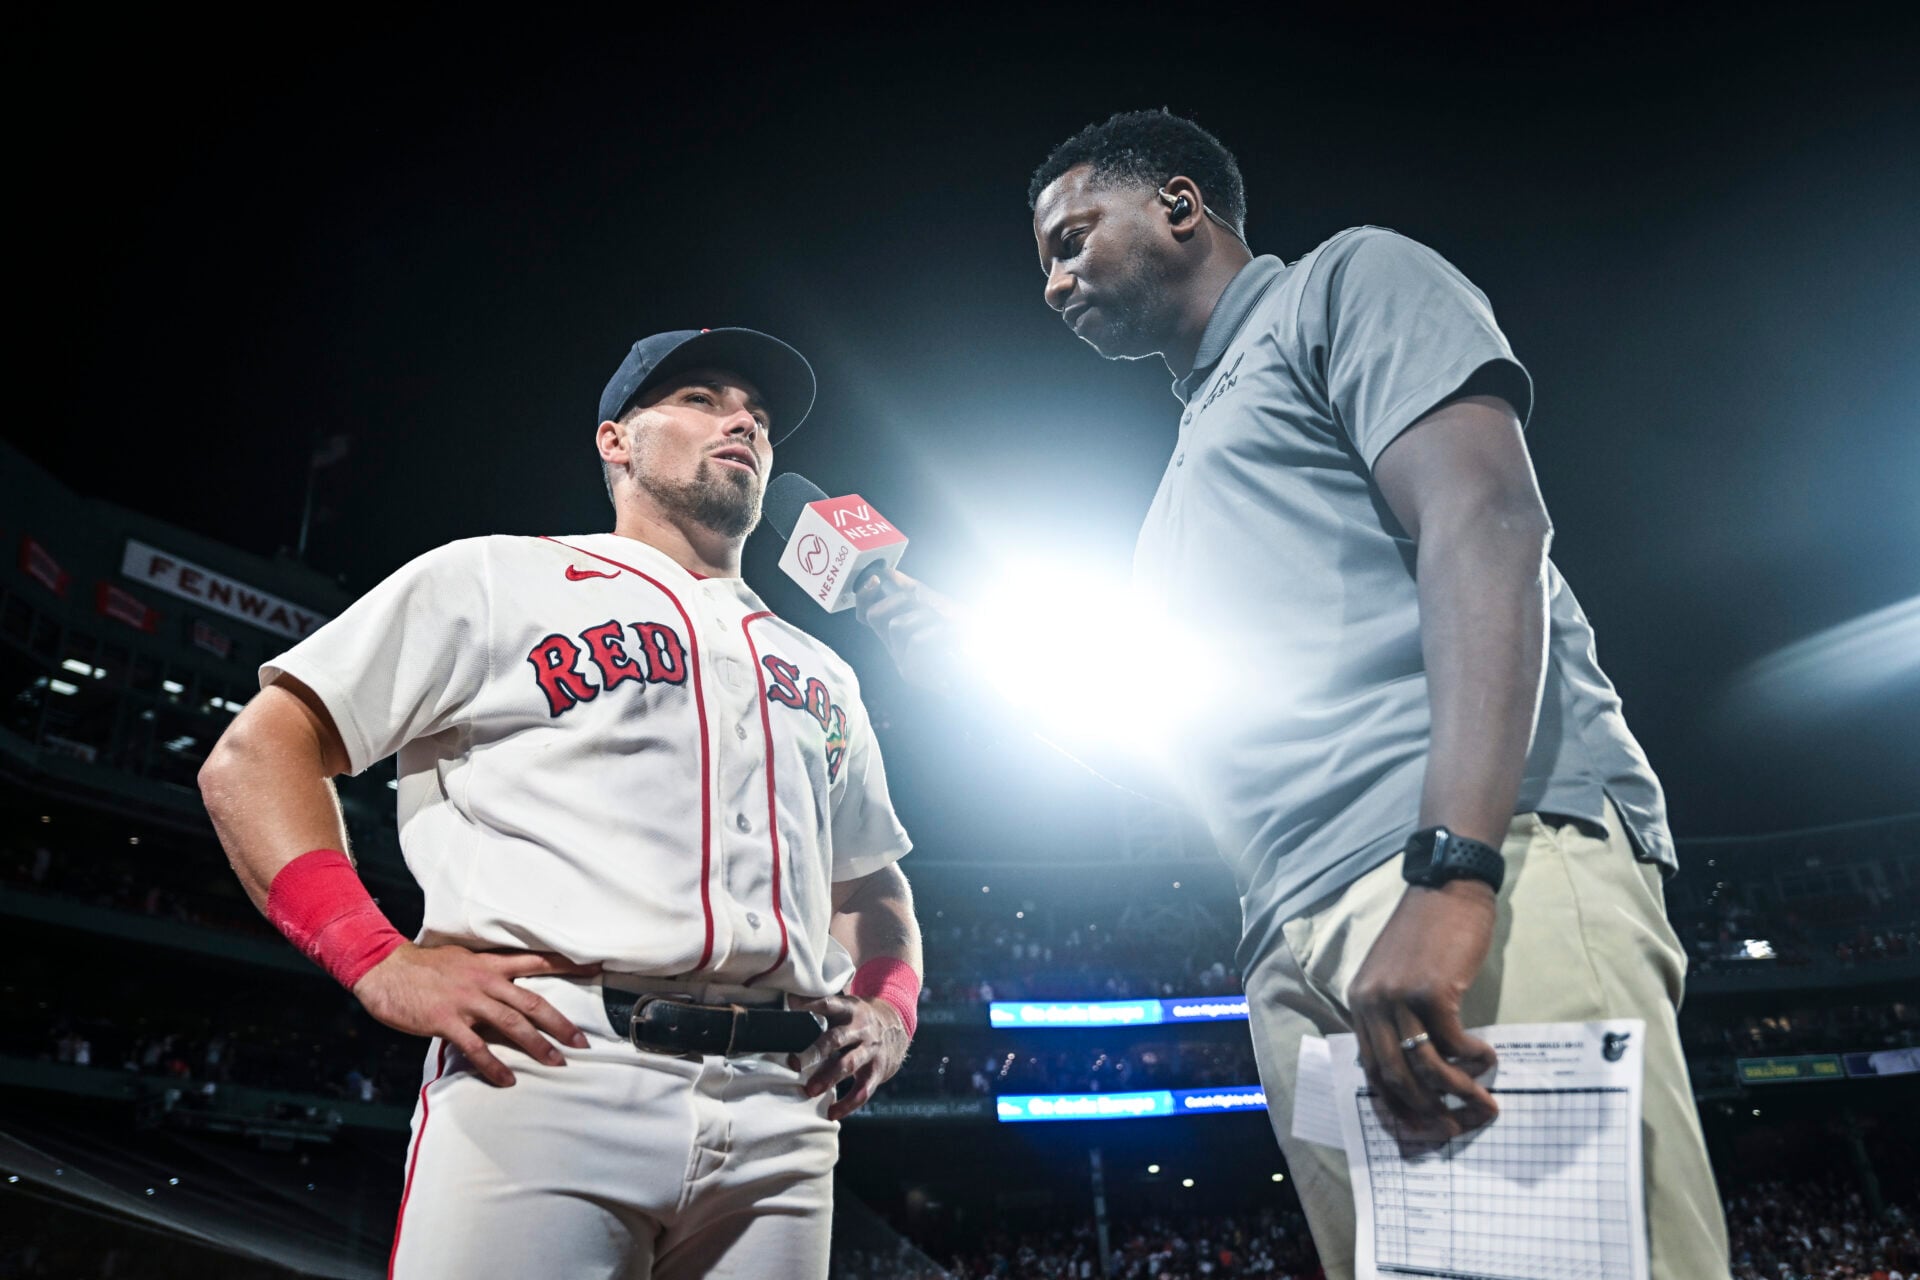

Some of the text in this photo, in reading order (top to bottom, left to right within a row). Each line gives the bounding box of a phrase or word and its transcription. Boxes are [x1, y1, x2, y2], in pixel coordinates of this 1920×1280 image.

[843, 521, 892, 540] NESN
[148, 555, 314, 634] FENWAY
[818, 545, 849, 601] NESN 360
[526, 619, 688, 718] RED
